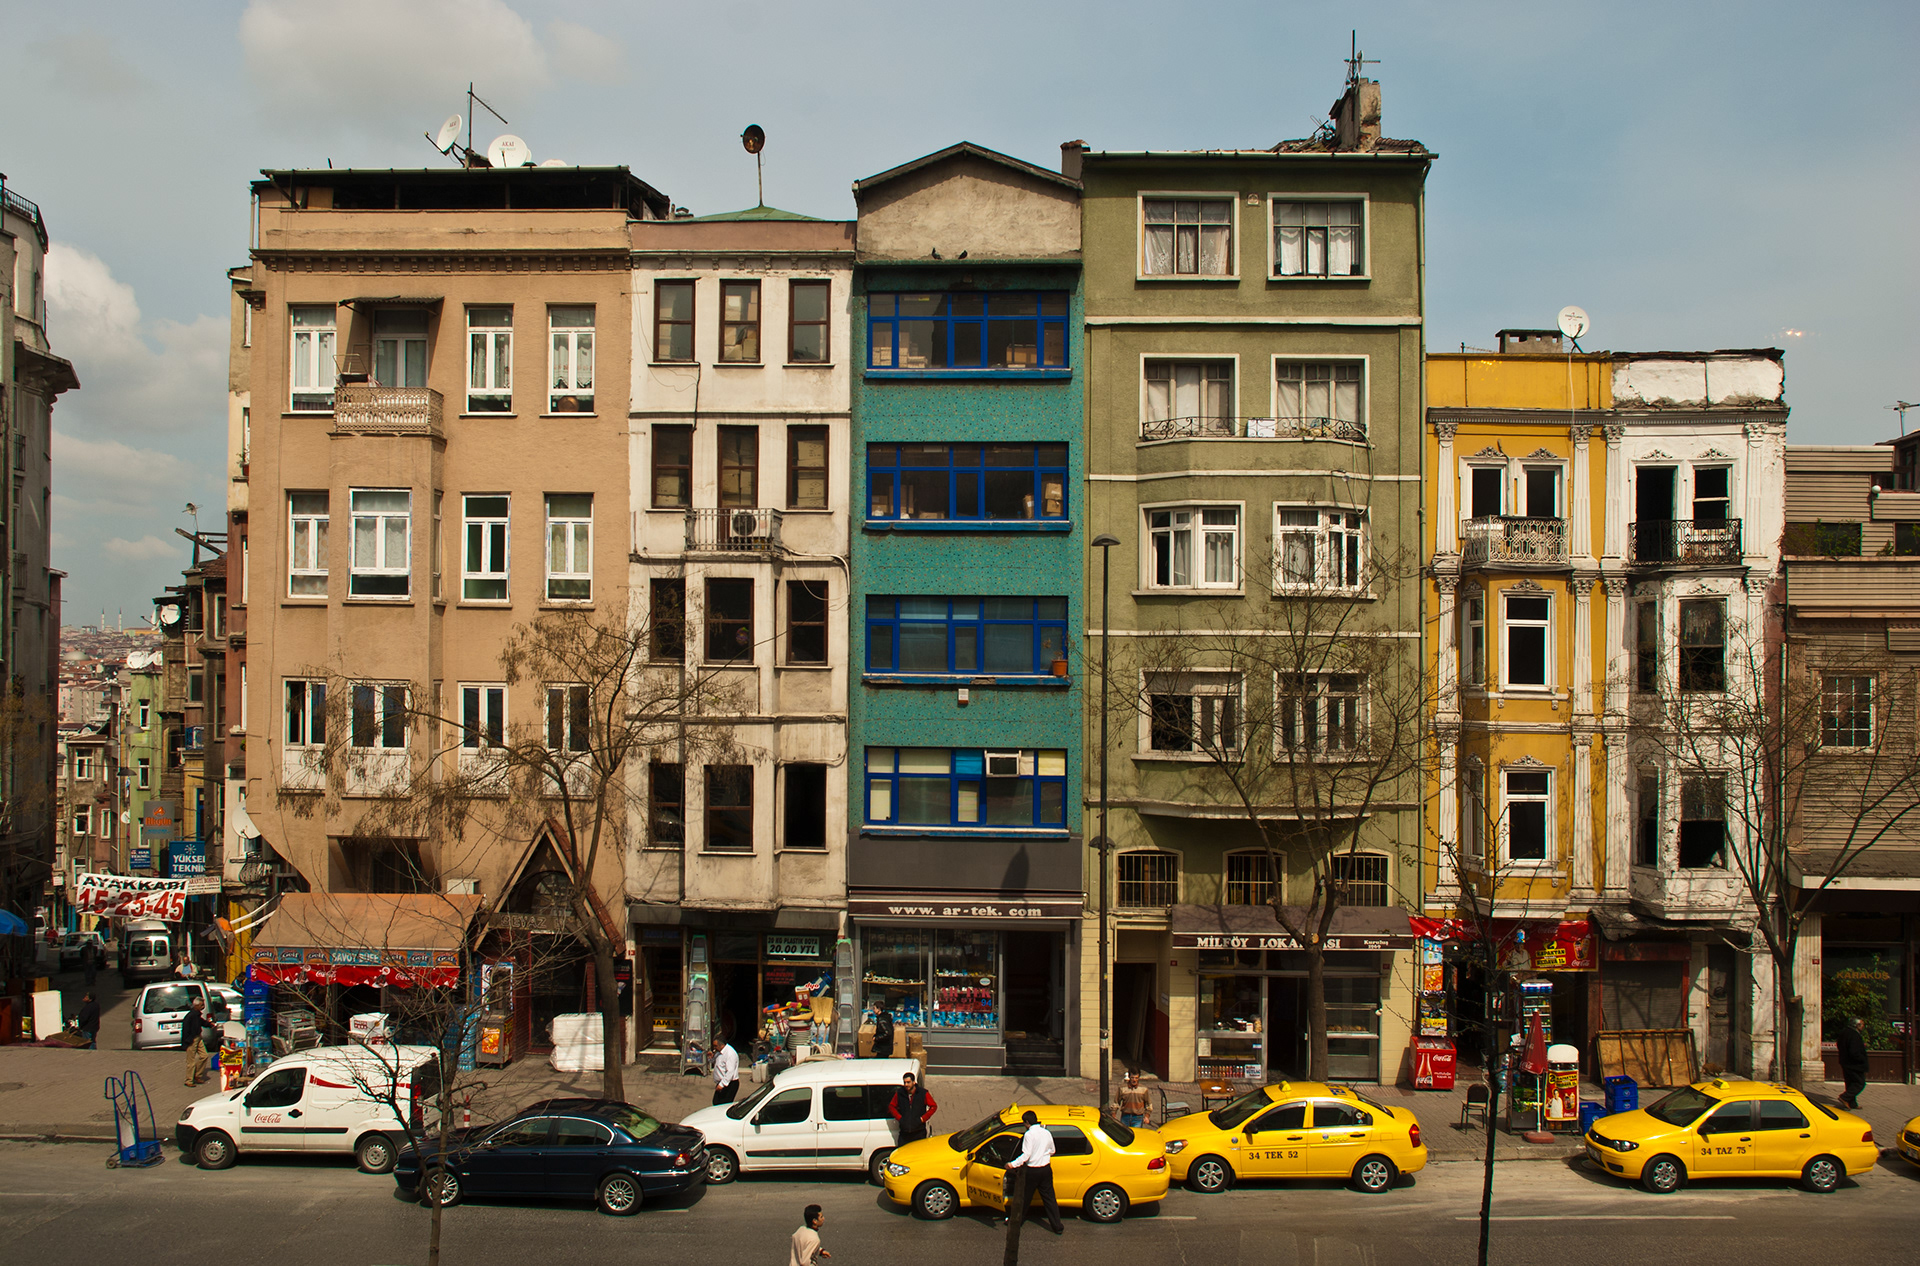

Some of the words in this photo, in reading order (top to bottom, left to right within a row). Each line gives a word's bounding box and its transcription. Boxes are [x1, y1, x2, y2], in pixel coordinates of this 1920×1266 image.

[83, 876, 187, 890] AYAKKABI
[79, 888, 186, 920] 15-25-45
[1008, 907, 1042, 917] com
[1197, 935, 1249, 948] MİLFÖY
[769, 944, 797, 954] 20.00
[800, 945, 817, 954] YTL
[980, 998, 992, 1007] 94
[1248, 1152, 1260, 1160] 34
[1265, 1151, 1283, 1159] TEK
[1288, 1150, 1299, 1159] 52
[1701, 1148, 1712, 1156] 34
[1715, 1147, 1733, 1155] TAZ
[1736, 1146, 1747, 1155] 75
[968, 1186, 977, 1195] 34
[979, 1190, 991, 1199] TCV
